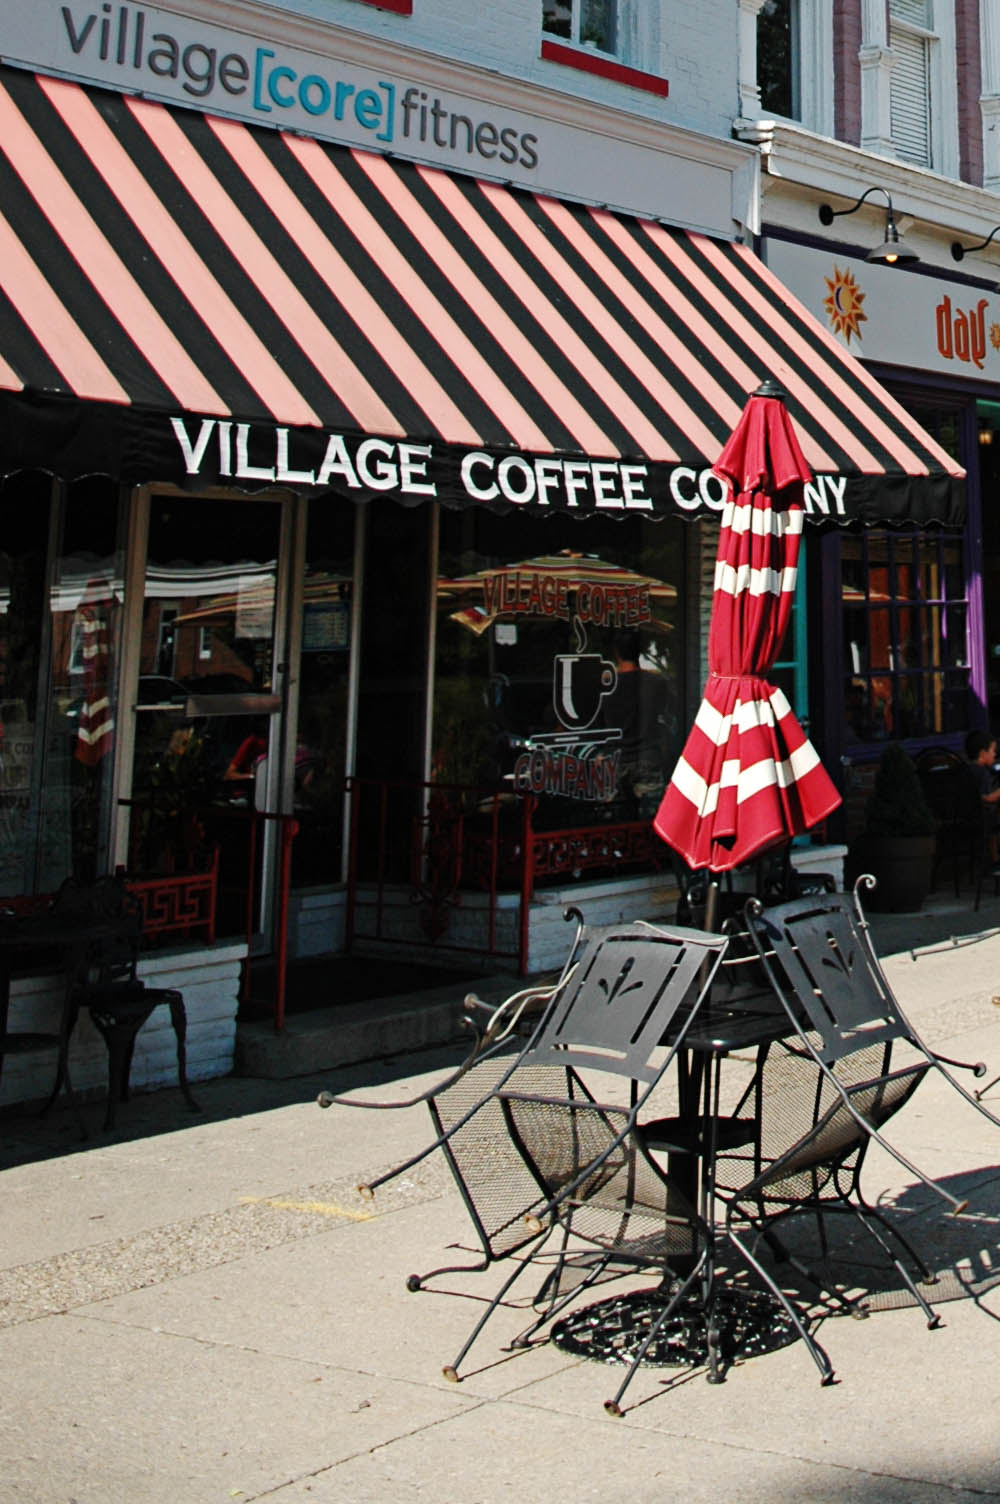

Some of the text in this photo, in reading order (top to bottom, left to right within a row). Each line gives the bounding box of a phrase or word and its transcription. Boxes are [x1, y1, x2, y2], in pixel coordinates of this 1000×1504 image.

[936, 294, 989, 370] day
[169, 417, 848, 515] VILLAGE COFFEE CONY
[483, 571, 651, 628] VILLAGE COFFEE
[513, 747, 622, 801] COMPANY
